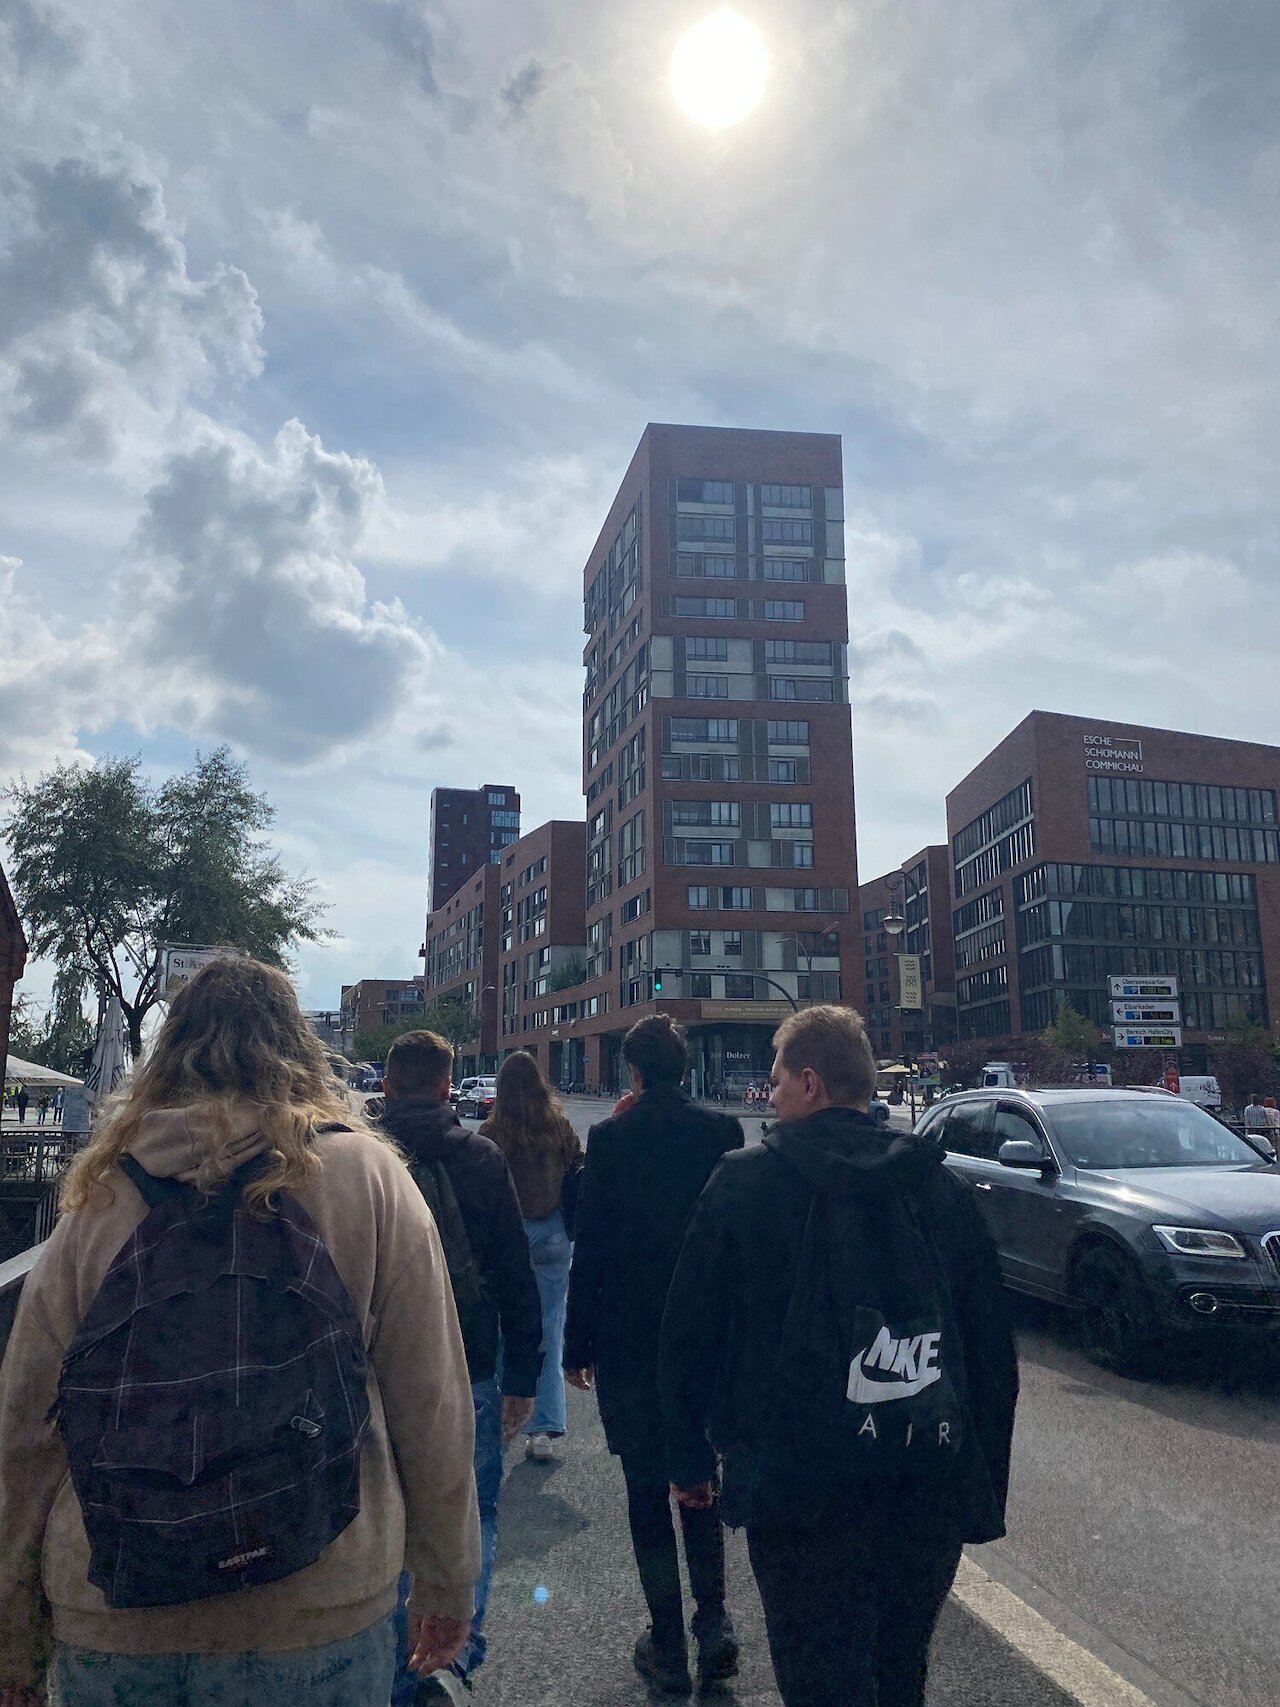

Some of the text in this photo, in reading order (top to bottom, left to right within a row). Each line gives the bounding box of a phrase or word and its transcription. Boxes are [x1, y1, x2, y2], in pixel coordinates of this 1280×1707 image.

[1083, 735, 1112, 746] ESCHE
[1085, 760, 1144, 772] COMMICHAU
[726, 1051, 751, 1059] Dolzer
[857, 1412, 951, 1447] AIR
